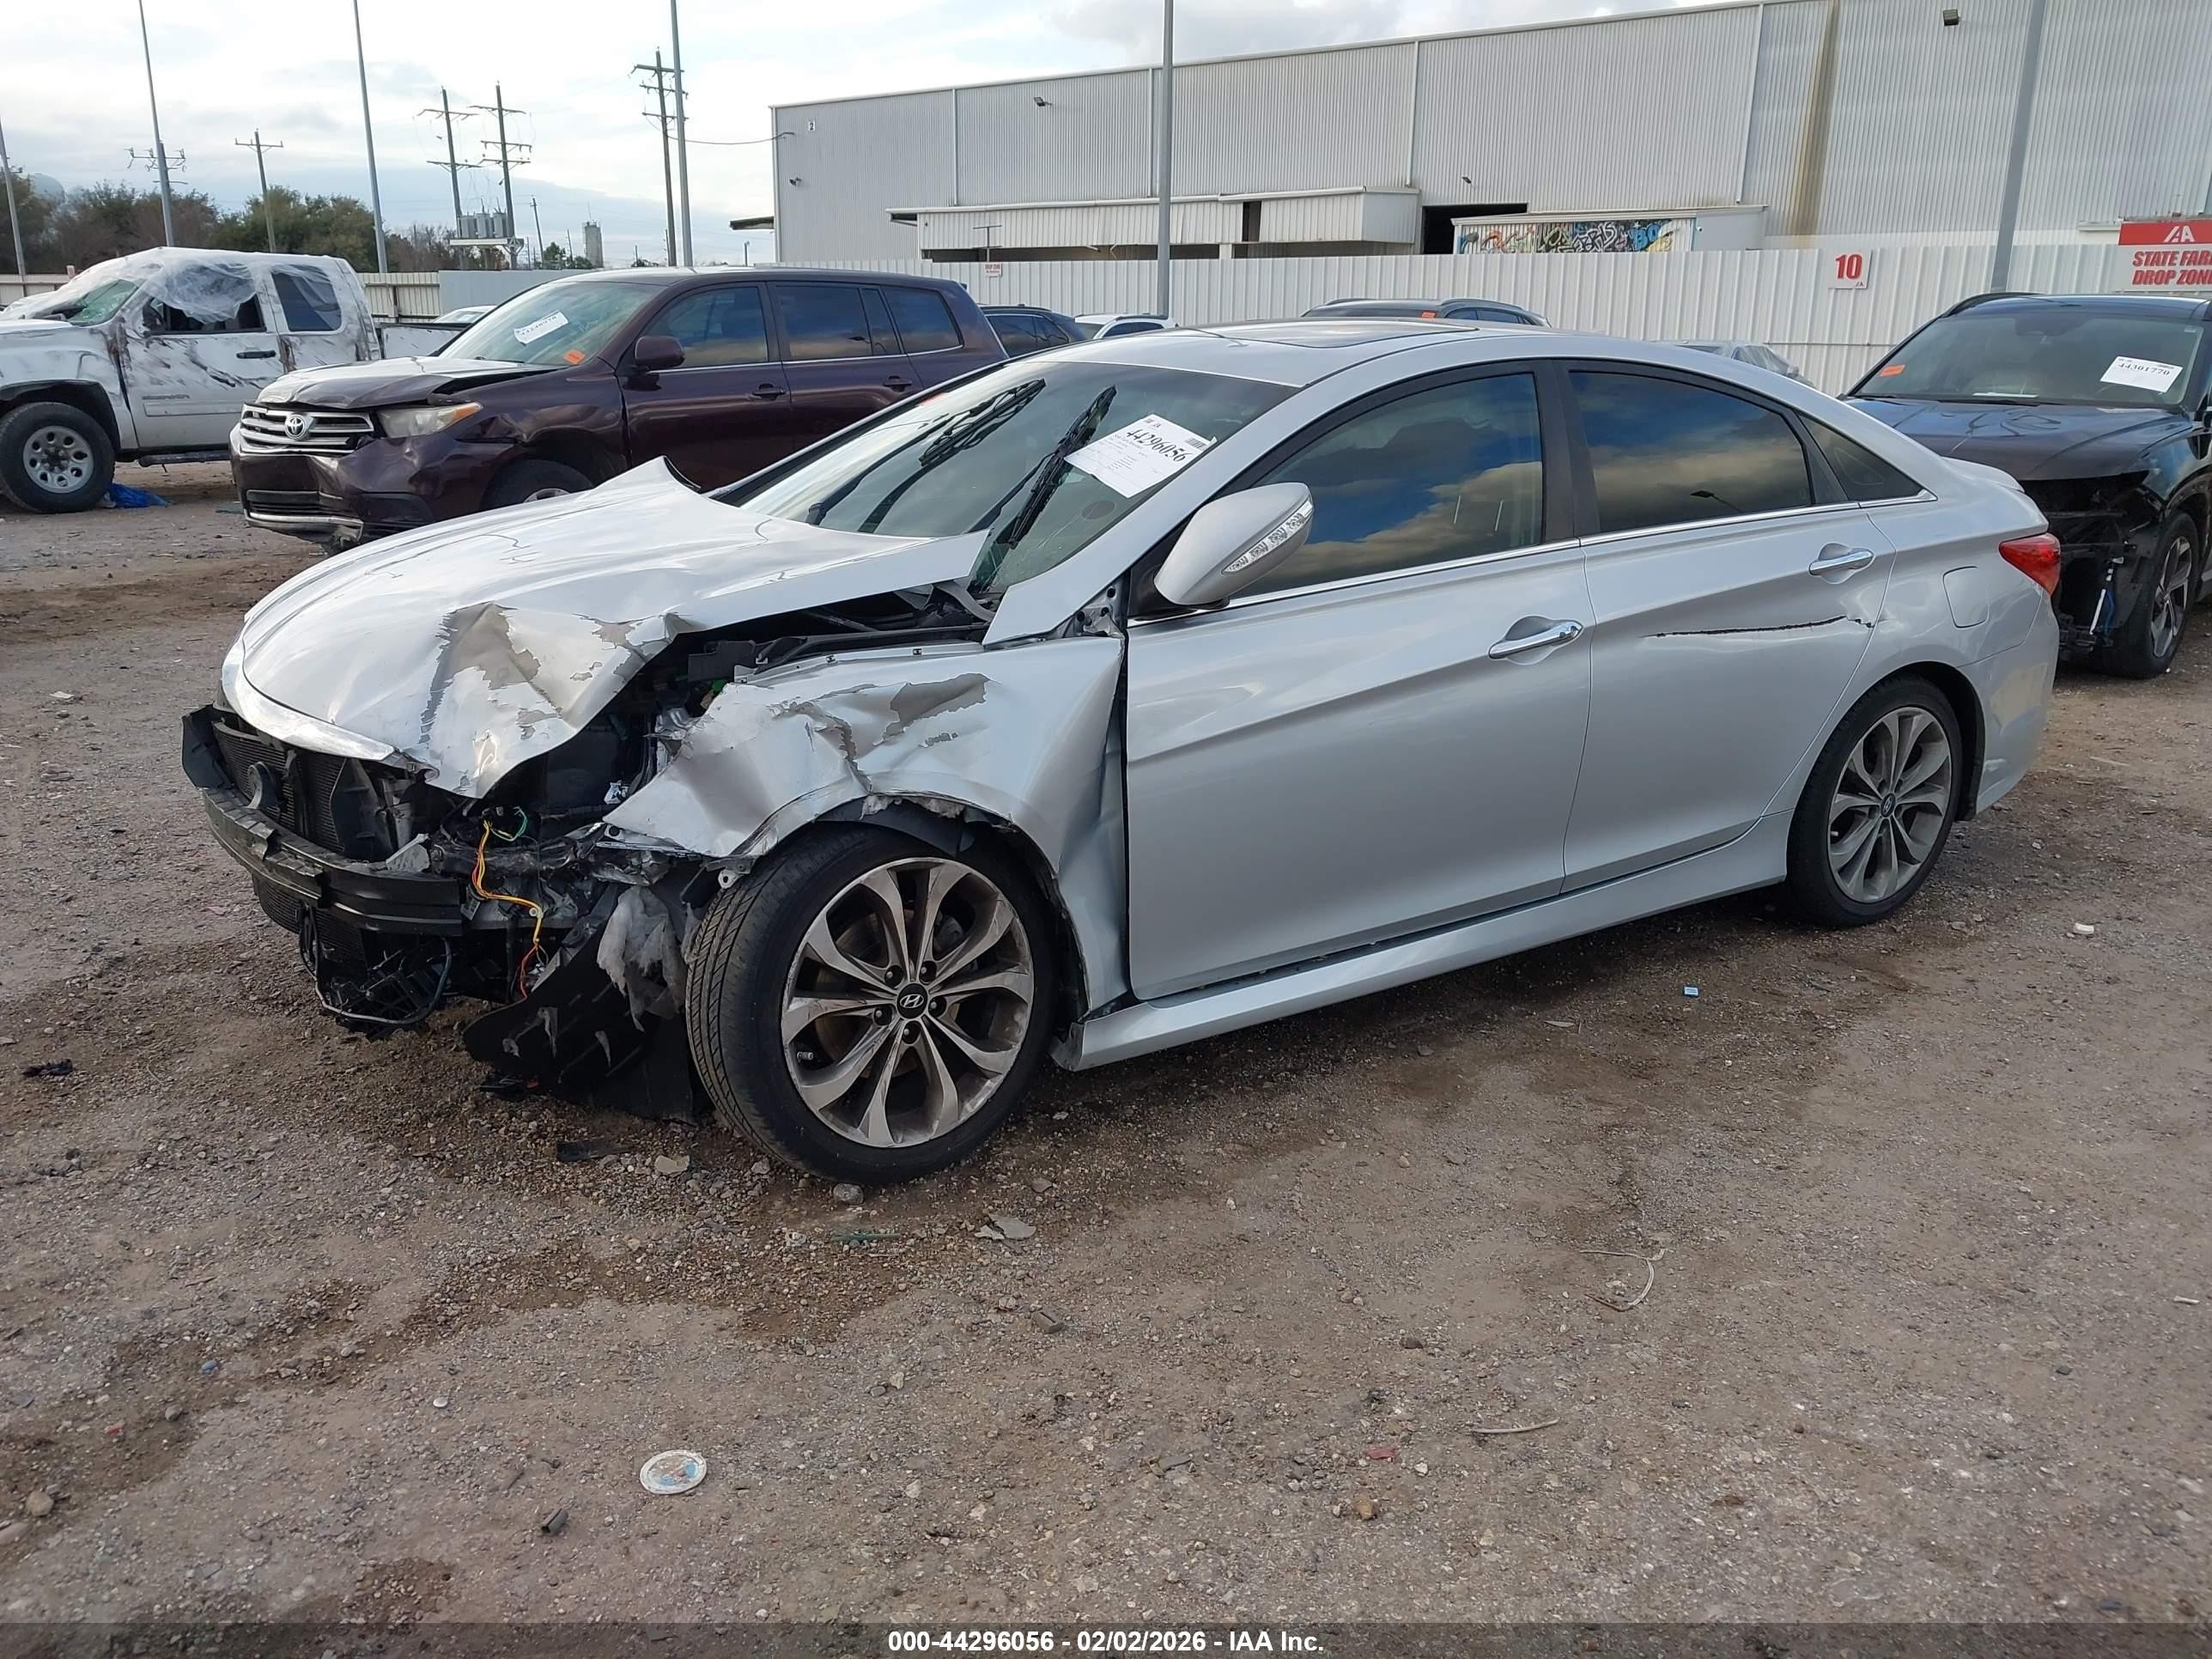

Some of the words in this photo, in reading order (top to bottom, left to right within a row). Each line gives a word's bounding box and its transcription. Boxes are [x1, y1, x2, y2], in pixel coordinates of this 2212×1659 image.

[1835, 253, 1863, 280] 10
[2132, 250, 2179, 267] STATE
[2179, 250, 2212, 266] FAR
[2132, 270, 2177, 285] DROP
[1126, 428, 1193, 462] 44296056
